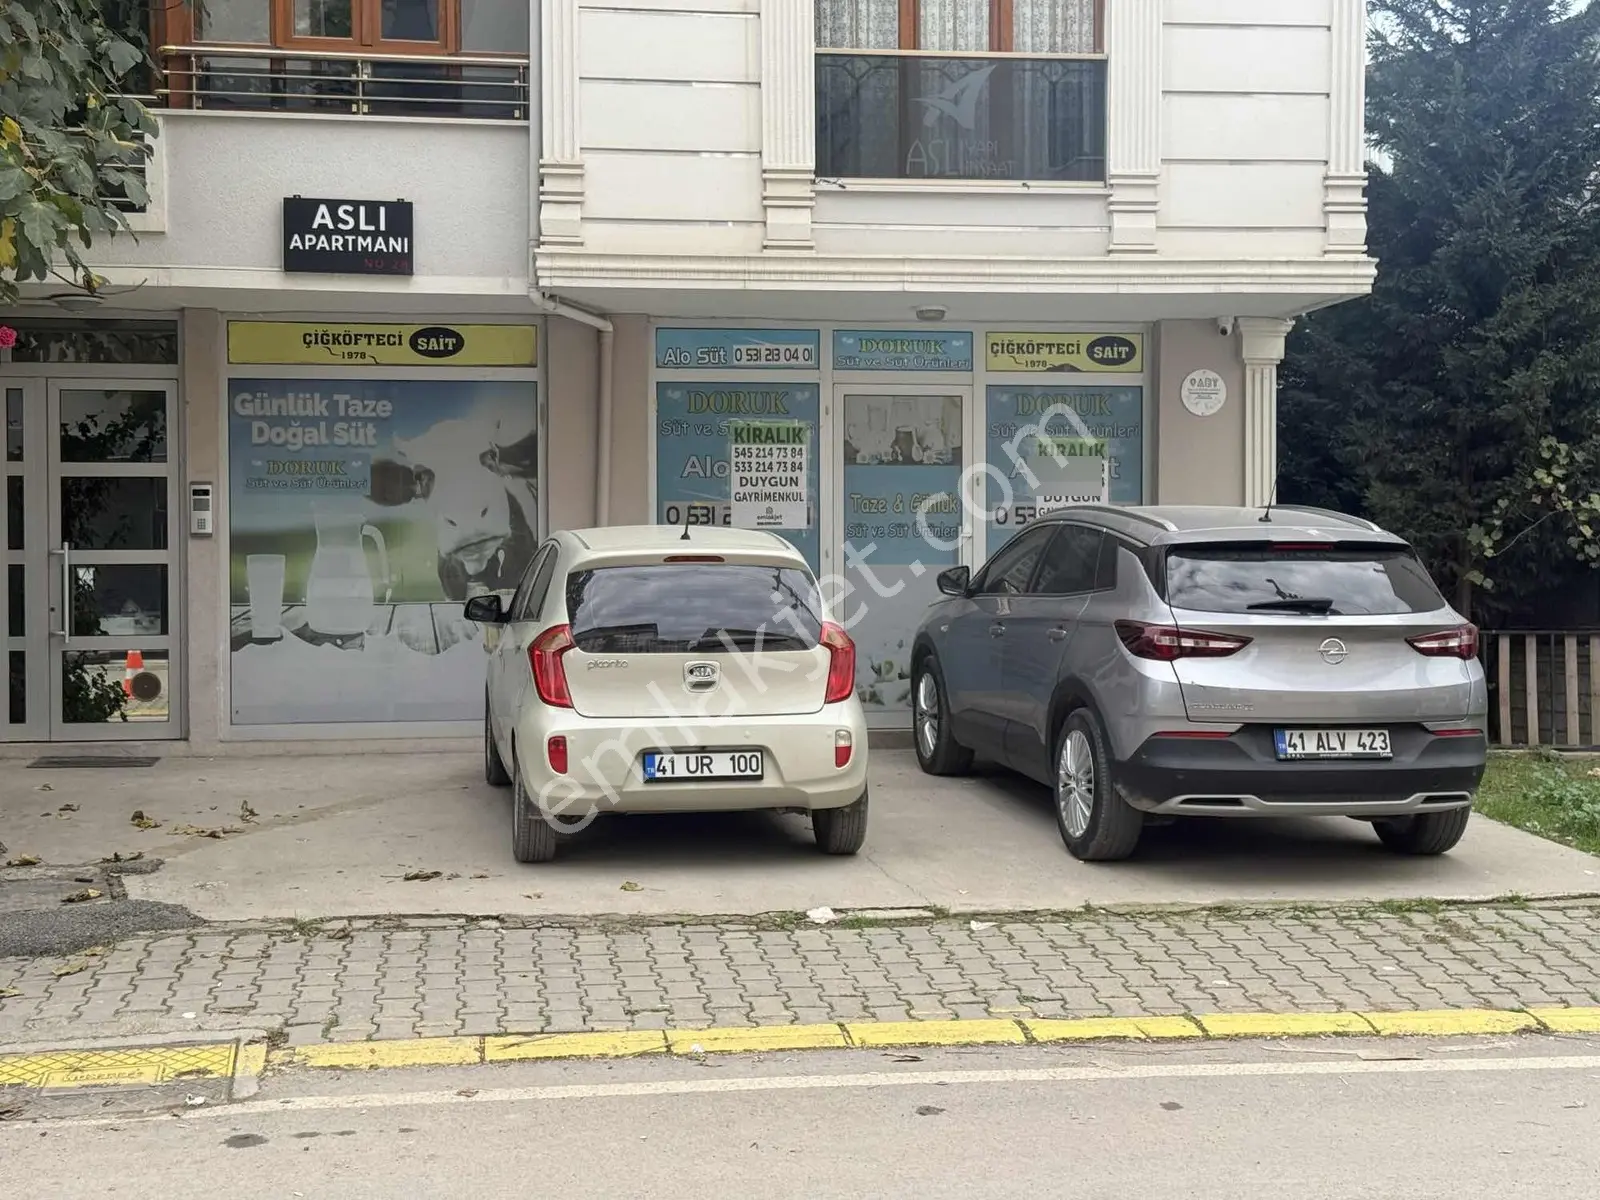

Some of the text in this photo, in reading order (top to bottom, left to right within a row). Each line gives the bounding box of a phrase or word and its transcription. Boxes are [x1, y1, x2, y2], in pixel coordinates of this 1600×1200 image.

[311, 204, 387, 232] ASLI
[289, 234, 409, 253] APARTMANI
[302, 328, 457, 351] ÇİĞKÖFTECİ SAİT
[858, 338, 947, 355] DORUK
[990, 339, 1129, 359] ÇİĞKÖFTECİ SAİT
[340, 351, 367, 360] 1978
[664, 347, 691, 364] Alo
[697, 347, 727, 364] Süt
[734, 348, 743, 363] 0
[784, 348, 800, 363] 04
[865, 358, 881, 367] ve
[234, 392, 394, 418] Günlük Taze
[687, 390, 789, 415] DORUK
[250, 420, 378, 451] Doğal Süt
[661, 420, 690, 436] Süt
[693, 424, 712, 436] ve
[733, 424, 804, 444] KİRALIK
[734, 447, 803, 459] 545 214 73 84
[267, 459, 346, 476] DORUK
[681, 455, 731, 478] Alo
[734, 461, 803, 473] 533 214 73 84
[739, 476, 799, 487] DUYGUN
[734, 490, 805, 502] GAYRİMENKUL
[850, 494, 888, 514] Taze
[893, 494, 904, 514] &
[666, 506, 680, 525] 0
[847, 523, 869, 538] Süt
[871, 526, 885, 538] ve
[888, 522, 910, 538] Süt
[692, 665, 714, 677] KIA
[1287, 732, 1306, 752] 41
[1316, 732, 1347, 752] ALV
[1357, 731, 1389, 751] 423
[656, 756, 676, 775] 41
[686, 756, 714, 774] UR
[729, 755, 760, 774] 100
